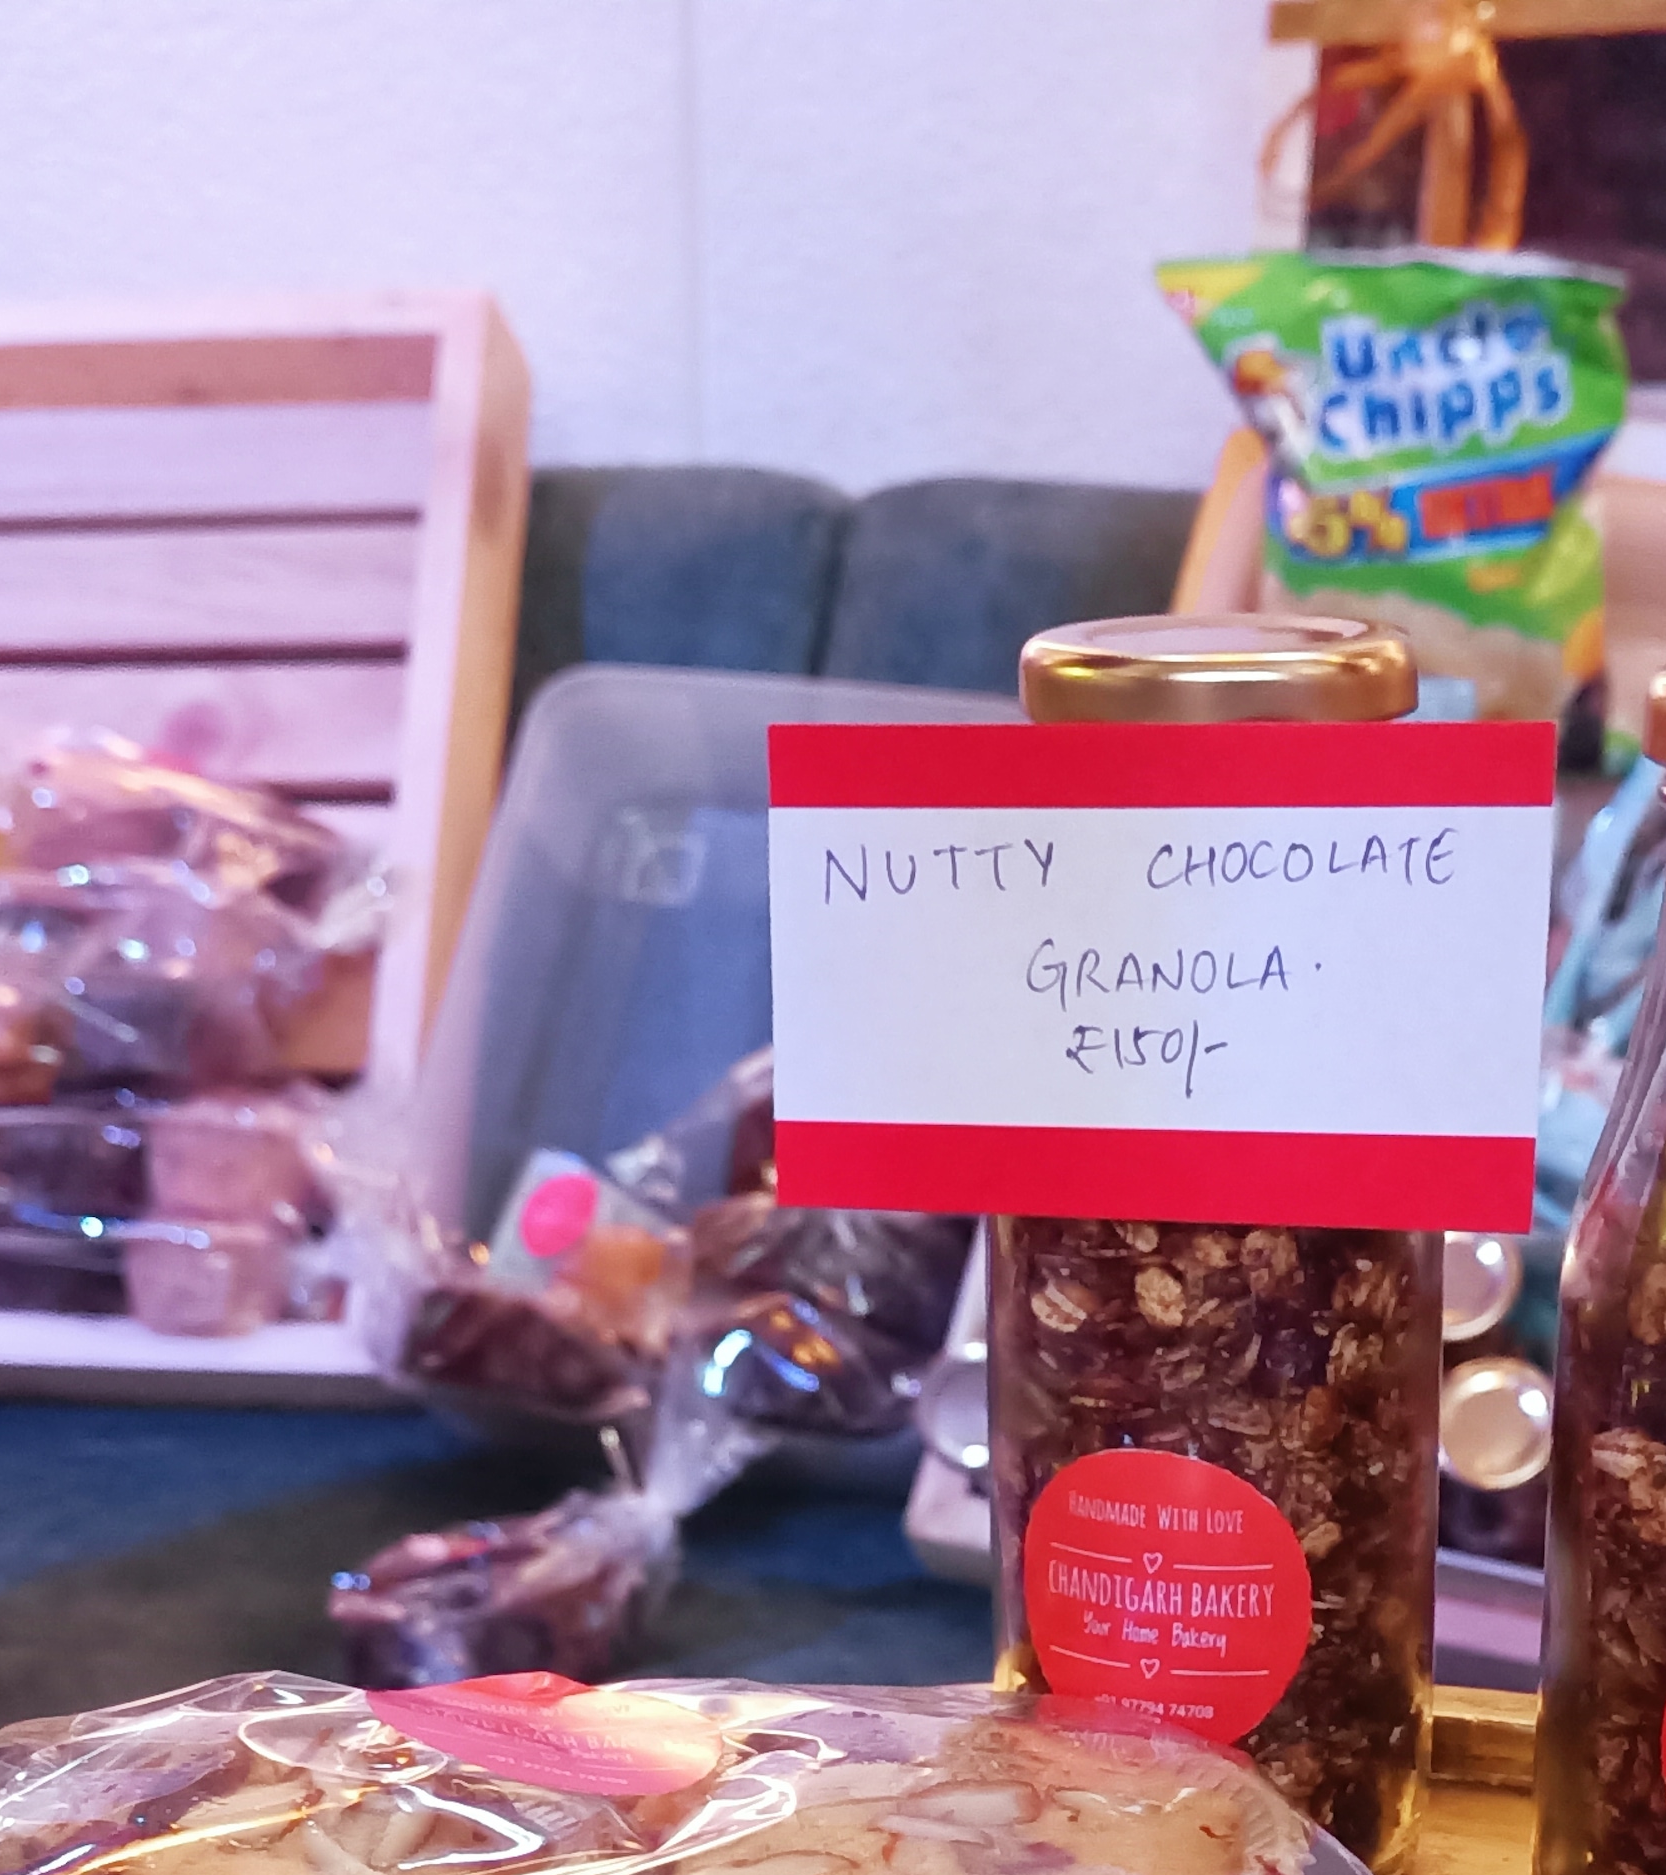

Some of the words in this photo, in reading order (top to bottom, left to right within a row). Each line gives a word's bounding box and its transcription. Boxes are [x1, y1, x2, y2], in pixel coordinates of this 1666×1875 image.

[1319, 368, 1562, 447] Chipps
[823, 838, 1055, 905] NUTTY
[1145, 827, 1458, 890] CHOCOLATE
[1068, 1490, 1146, 1529] HANDMADE
[1157, 1504, 1198, 1533] WITH
[1207, 1508, 1244, 1534] LOVE
[1048, 1559, 1182, 1615] CHANDIGARH
[1190, 1582, 1275, 1618] BAKERY
[1083, 1610, 1111, 1637] Your
[1122, 1618, 1159, 1645] Home
[1172, 1622, 1227, 1658] Bakery
